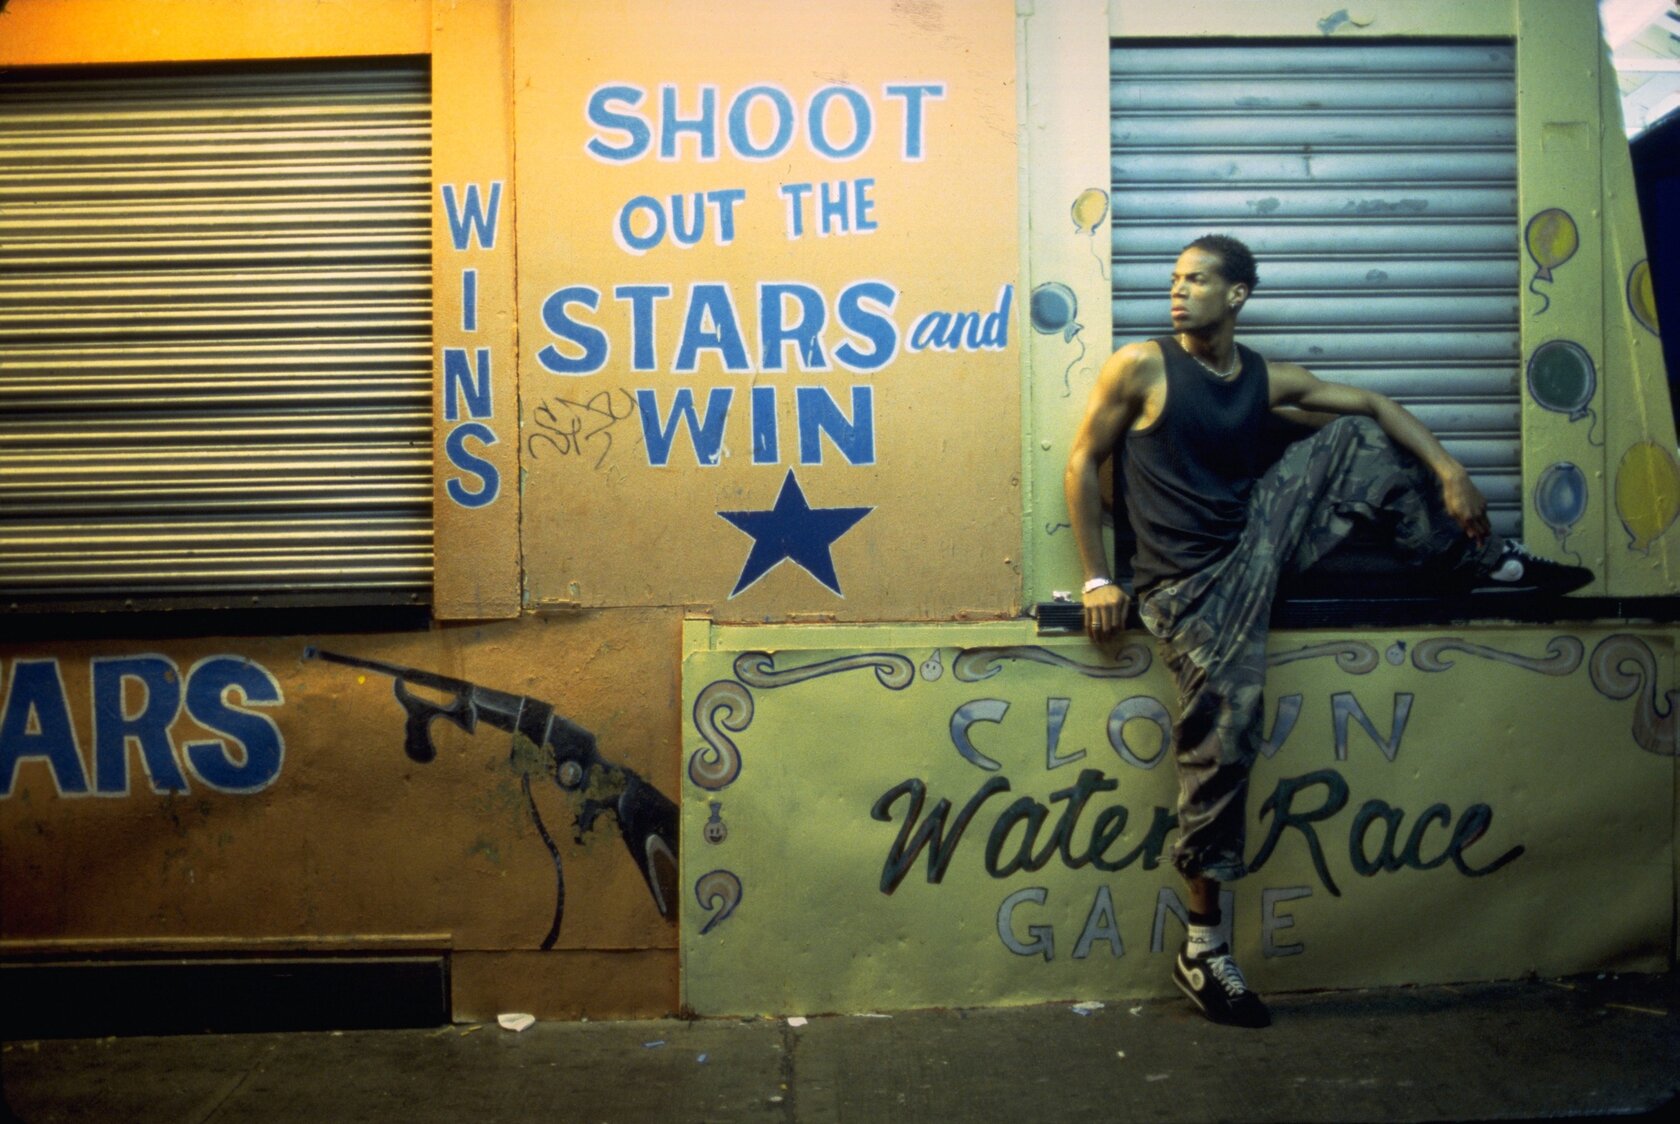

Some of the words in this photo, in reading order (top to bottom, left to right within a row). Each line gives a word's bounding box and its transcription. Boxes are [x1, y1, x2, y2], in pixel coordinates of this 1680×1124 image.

[582, 79, 948, 166] SHOOT
[613, 188, 746, 256] OUT
[779, 177, 879, 240] THE
[440, 179, 504, 509] WINS
[535, 279, 900, 376] STARS
[905, 282, 1015, 354] and
[635, 384, 877, 467] WIN
[870, 768, 1179, 896] Water
[1248, 768, 1525, 898] Race
